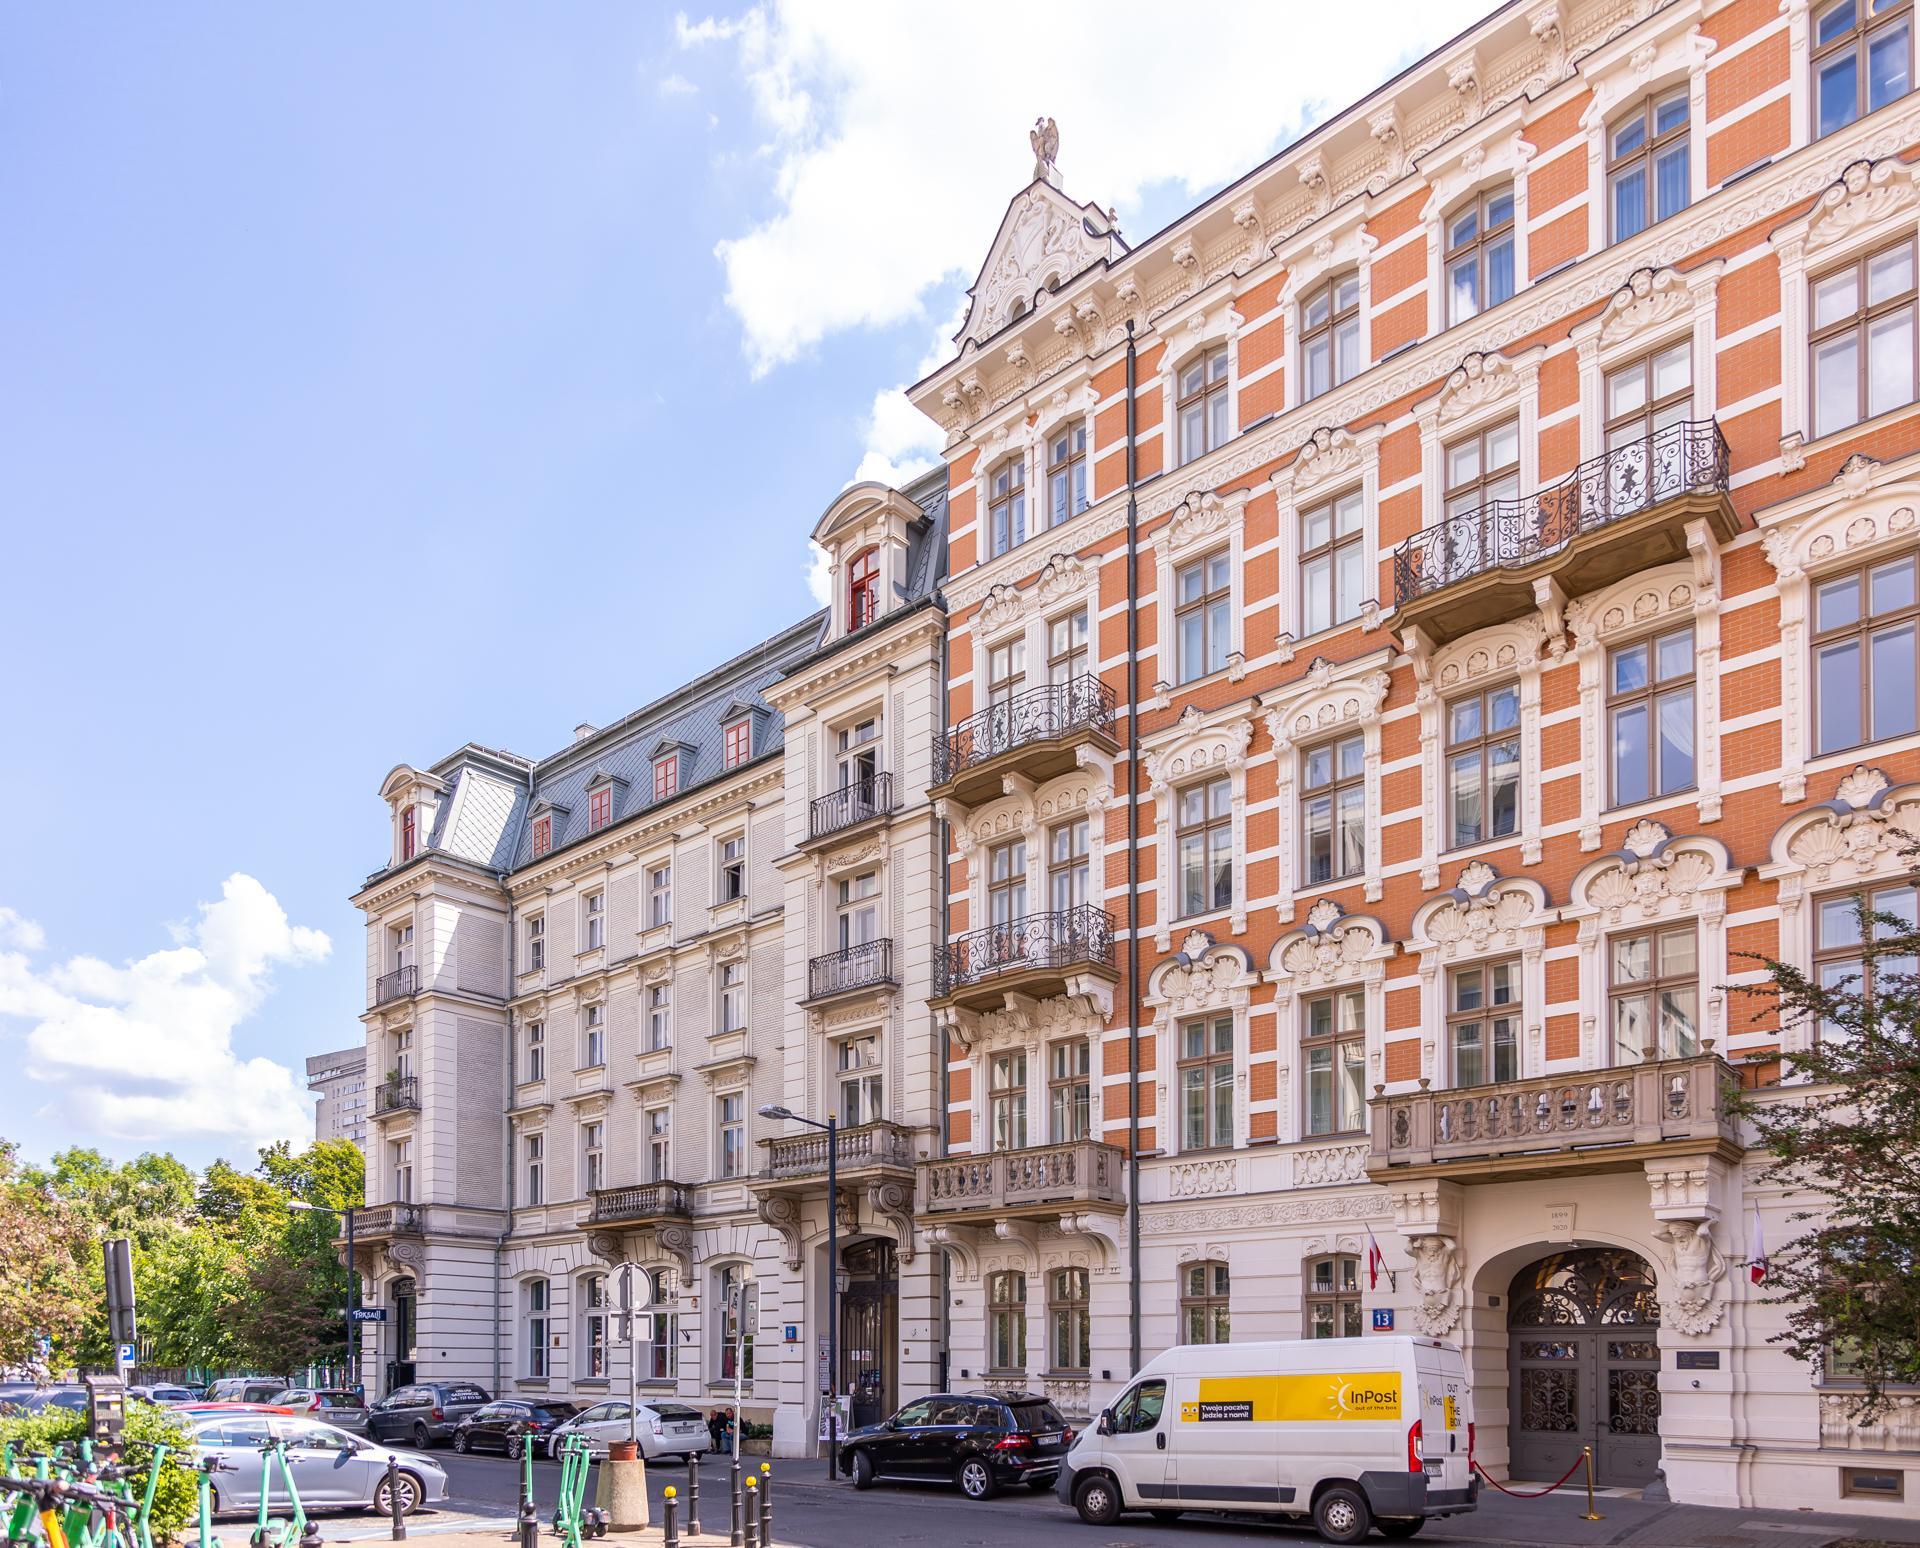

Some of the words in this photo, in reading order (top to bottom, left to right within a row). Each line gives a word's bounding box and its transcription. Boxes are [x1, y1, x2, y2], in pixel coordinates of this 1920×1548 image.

[1376, 1313, 1390, 1326] 13
[121, 1346, 131, 1360] P
[1447, 1383, 1458, 1393] OUT
[1351, 1389, 1397, 1404] InPost
[1448, 1395, 1456, 1404] OF
[1201, 1404, 1222, 1412] Twoja
[1223, 1404, 1249, 1412] paczka
[1449, 1406, 1460, 1415] THE
[1450, 1418, 1461, 1427] BOX
